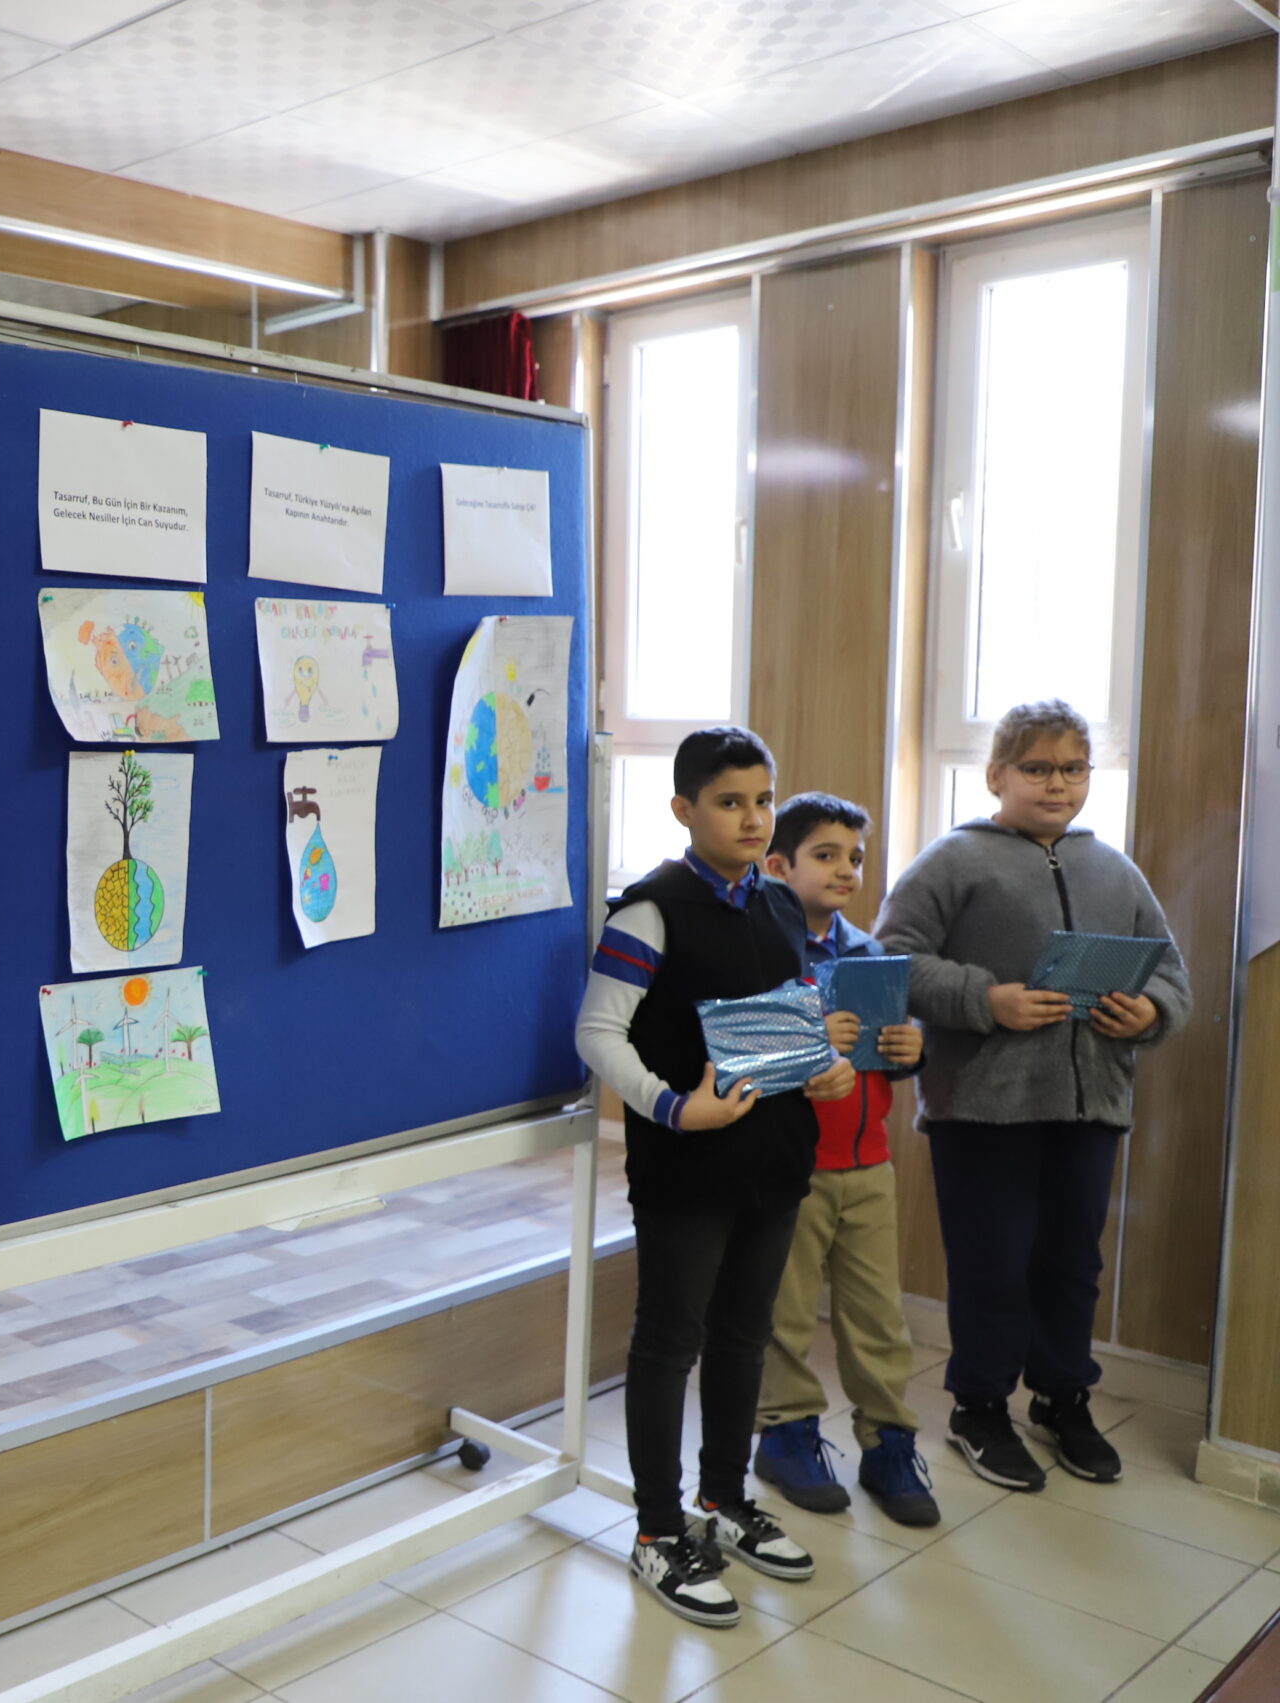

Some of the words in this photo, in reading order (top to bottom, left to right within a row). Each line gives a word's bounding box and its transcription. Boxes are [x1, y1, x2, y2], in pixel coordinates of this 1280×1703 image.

[53, 490, 91, 506] Tasarruf,
[92, 495, 104, 506] Bu
[105, 497, 122, 508] Gün
[123, 499, 138, 511] İçin
[139, 501, 151, 511] Bir
[152, 503, 189, 517] Kazanım,
[264, 487, 293, 503] Tasarruf,
[294, 493, 318, 507] Türkiye
[351, 505, 372, 517] Açılan
[53, 507, 88, 521] Gelecek
[88, 512, 120, 524] Nesiller
[121, 513, 136, 527] İçin
[138, 517, 153, 527] Can
[155, 520, 189, 532] Suyudur.
